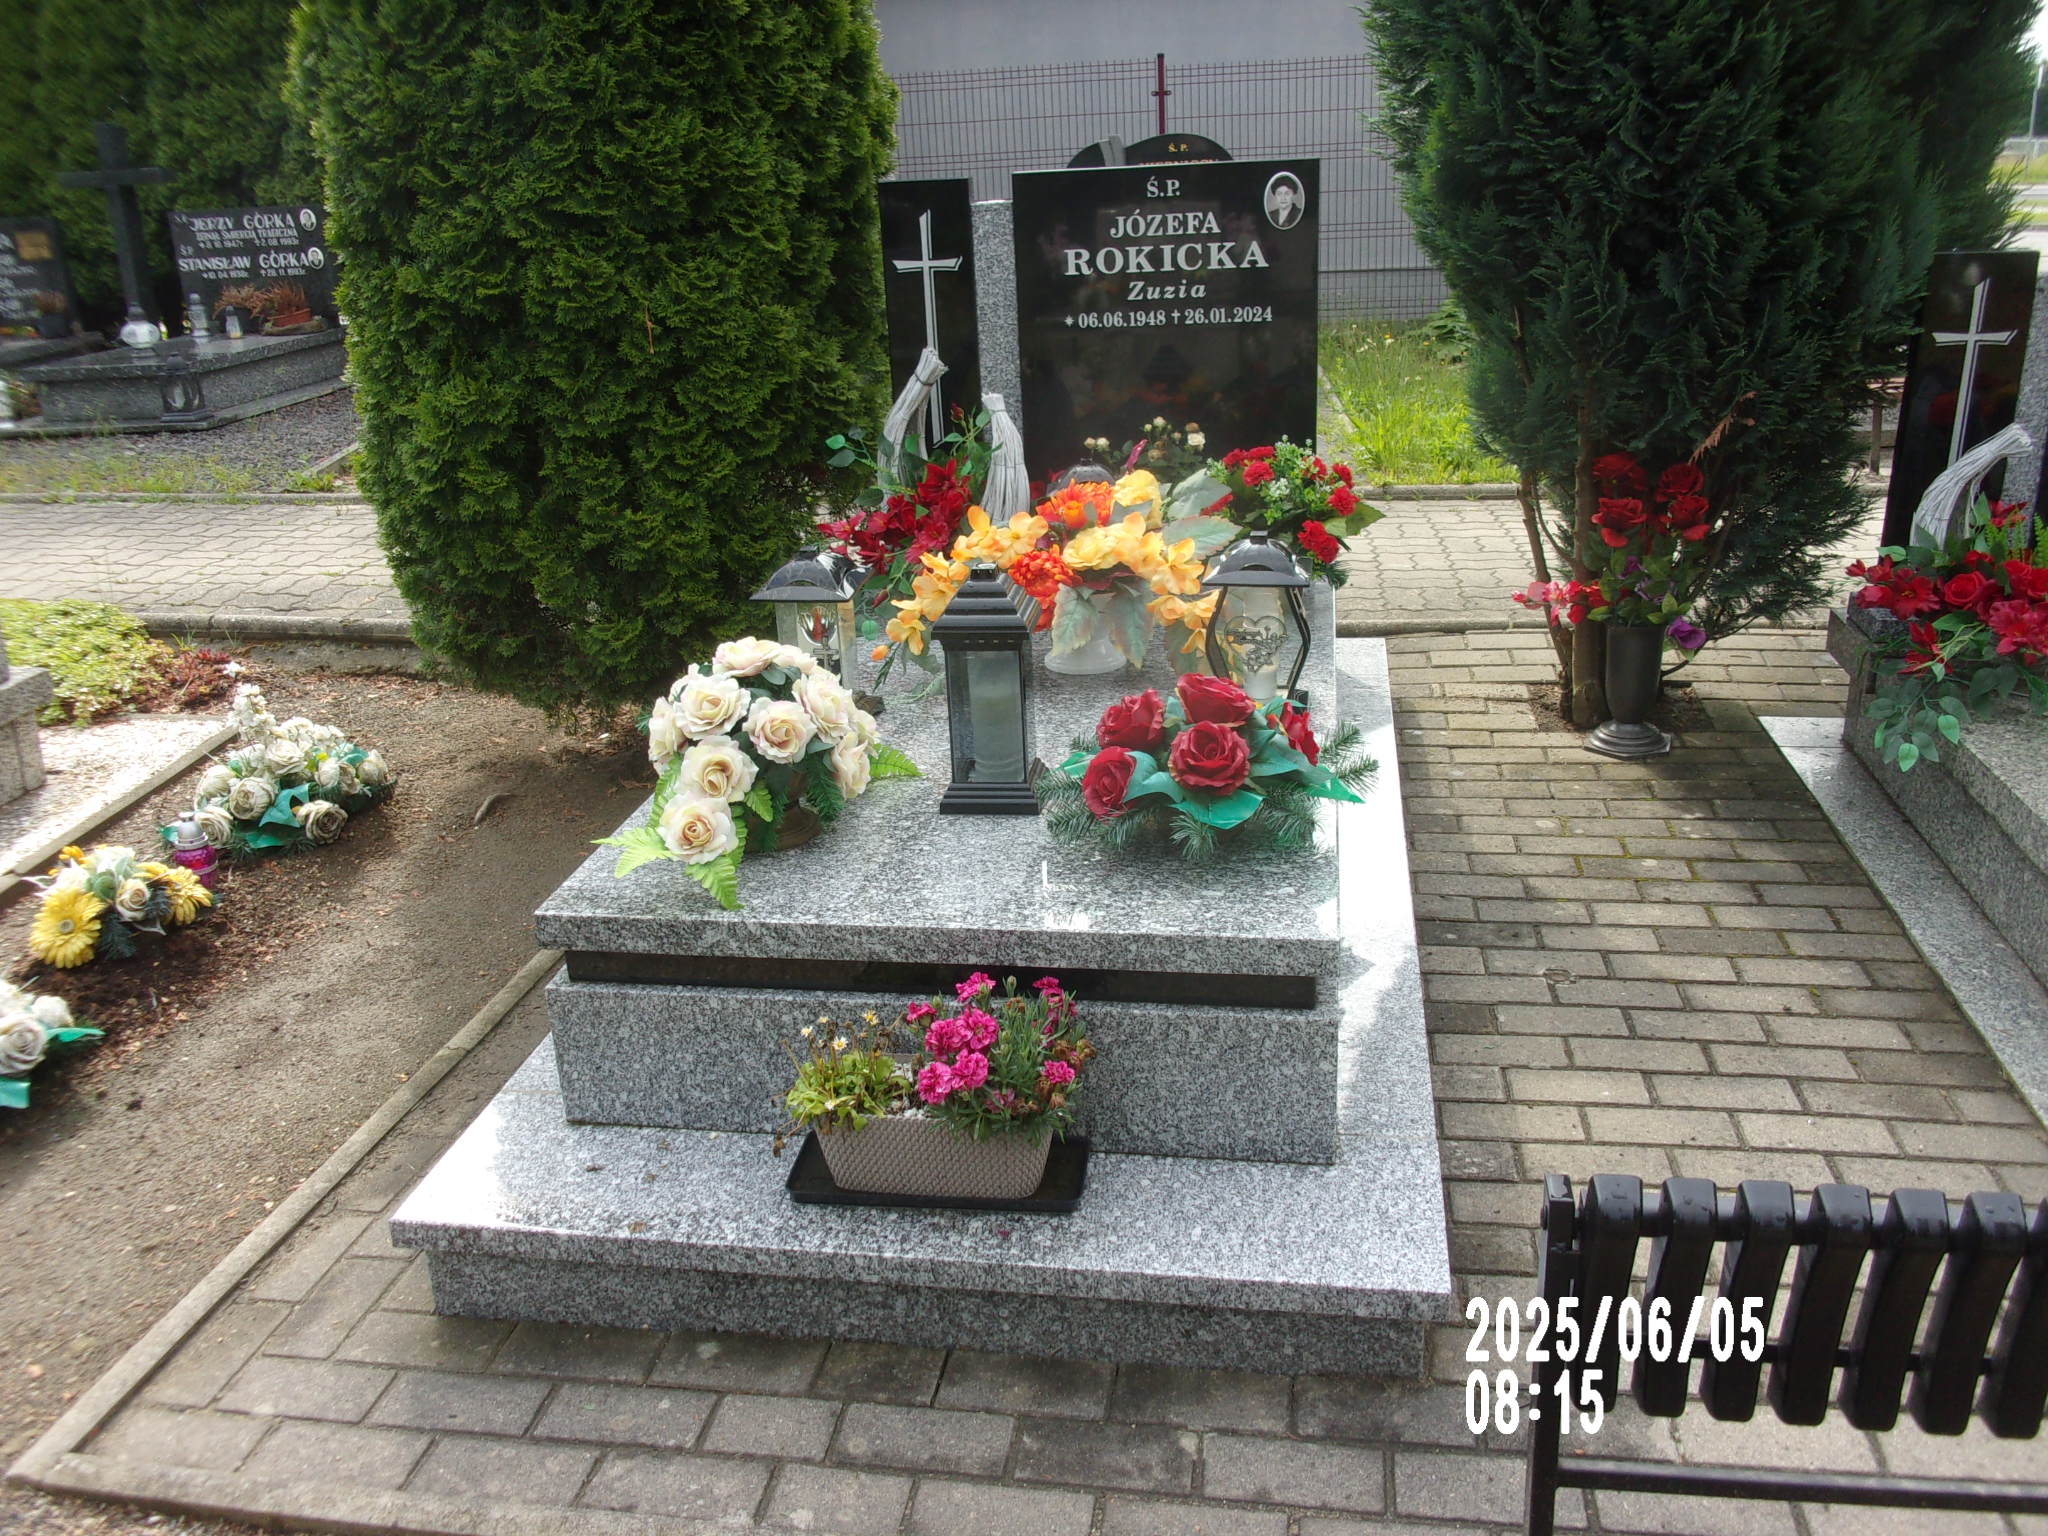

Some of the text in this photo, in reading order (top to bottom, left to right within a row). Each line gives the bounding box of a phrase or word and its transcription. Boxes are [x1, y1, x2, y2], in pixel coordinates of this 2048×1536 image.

[1146, 176, 1181, 198] Ś.P.
[189, 216, 234, 232] JERZY
[243, 211, 296, 230] GÓRKA
[1109, 209, 1222, 239] JÓZEFA
[178, 250, 310, 272] STANISŁAW GÓRKA
[1064, 240, 1270, 277] ROKICKA
[1127, 279, 1207, 301] Zuzia
[1078, 306, 1273, 329] 06.06.1948 26.01.2024
